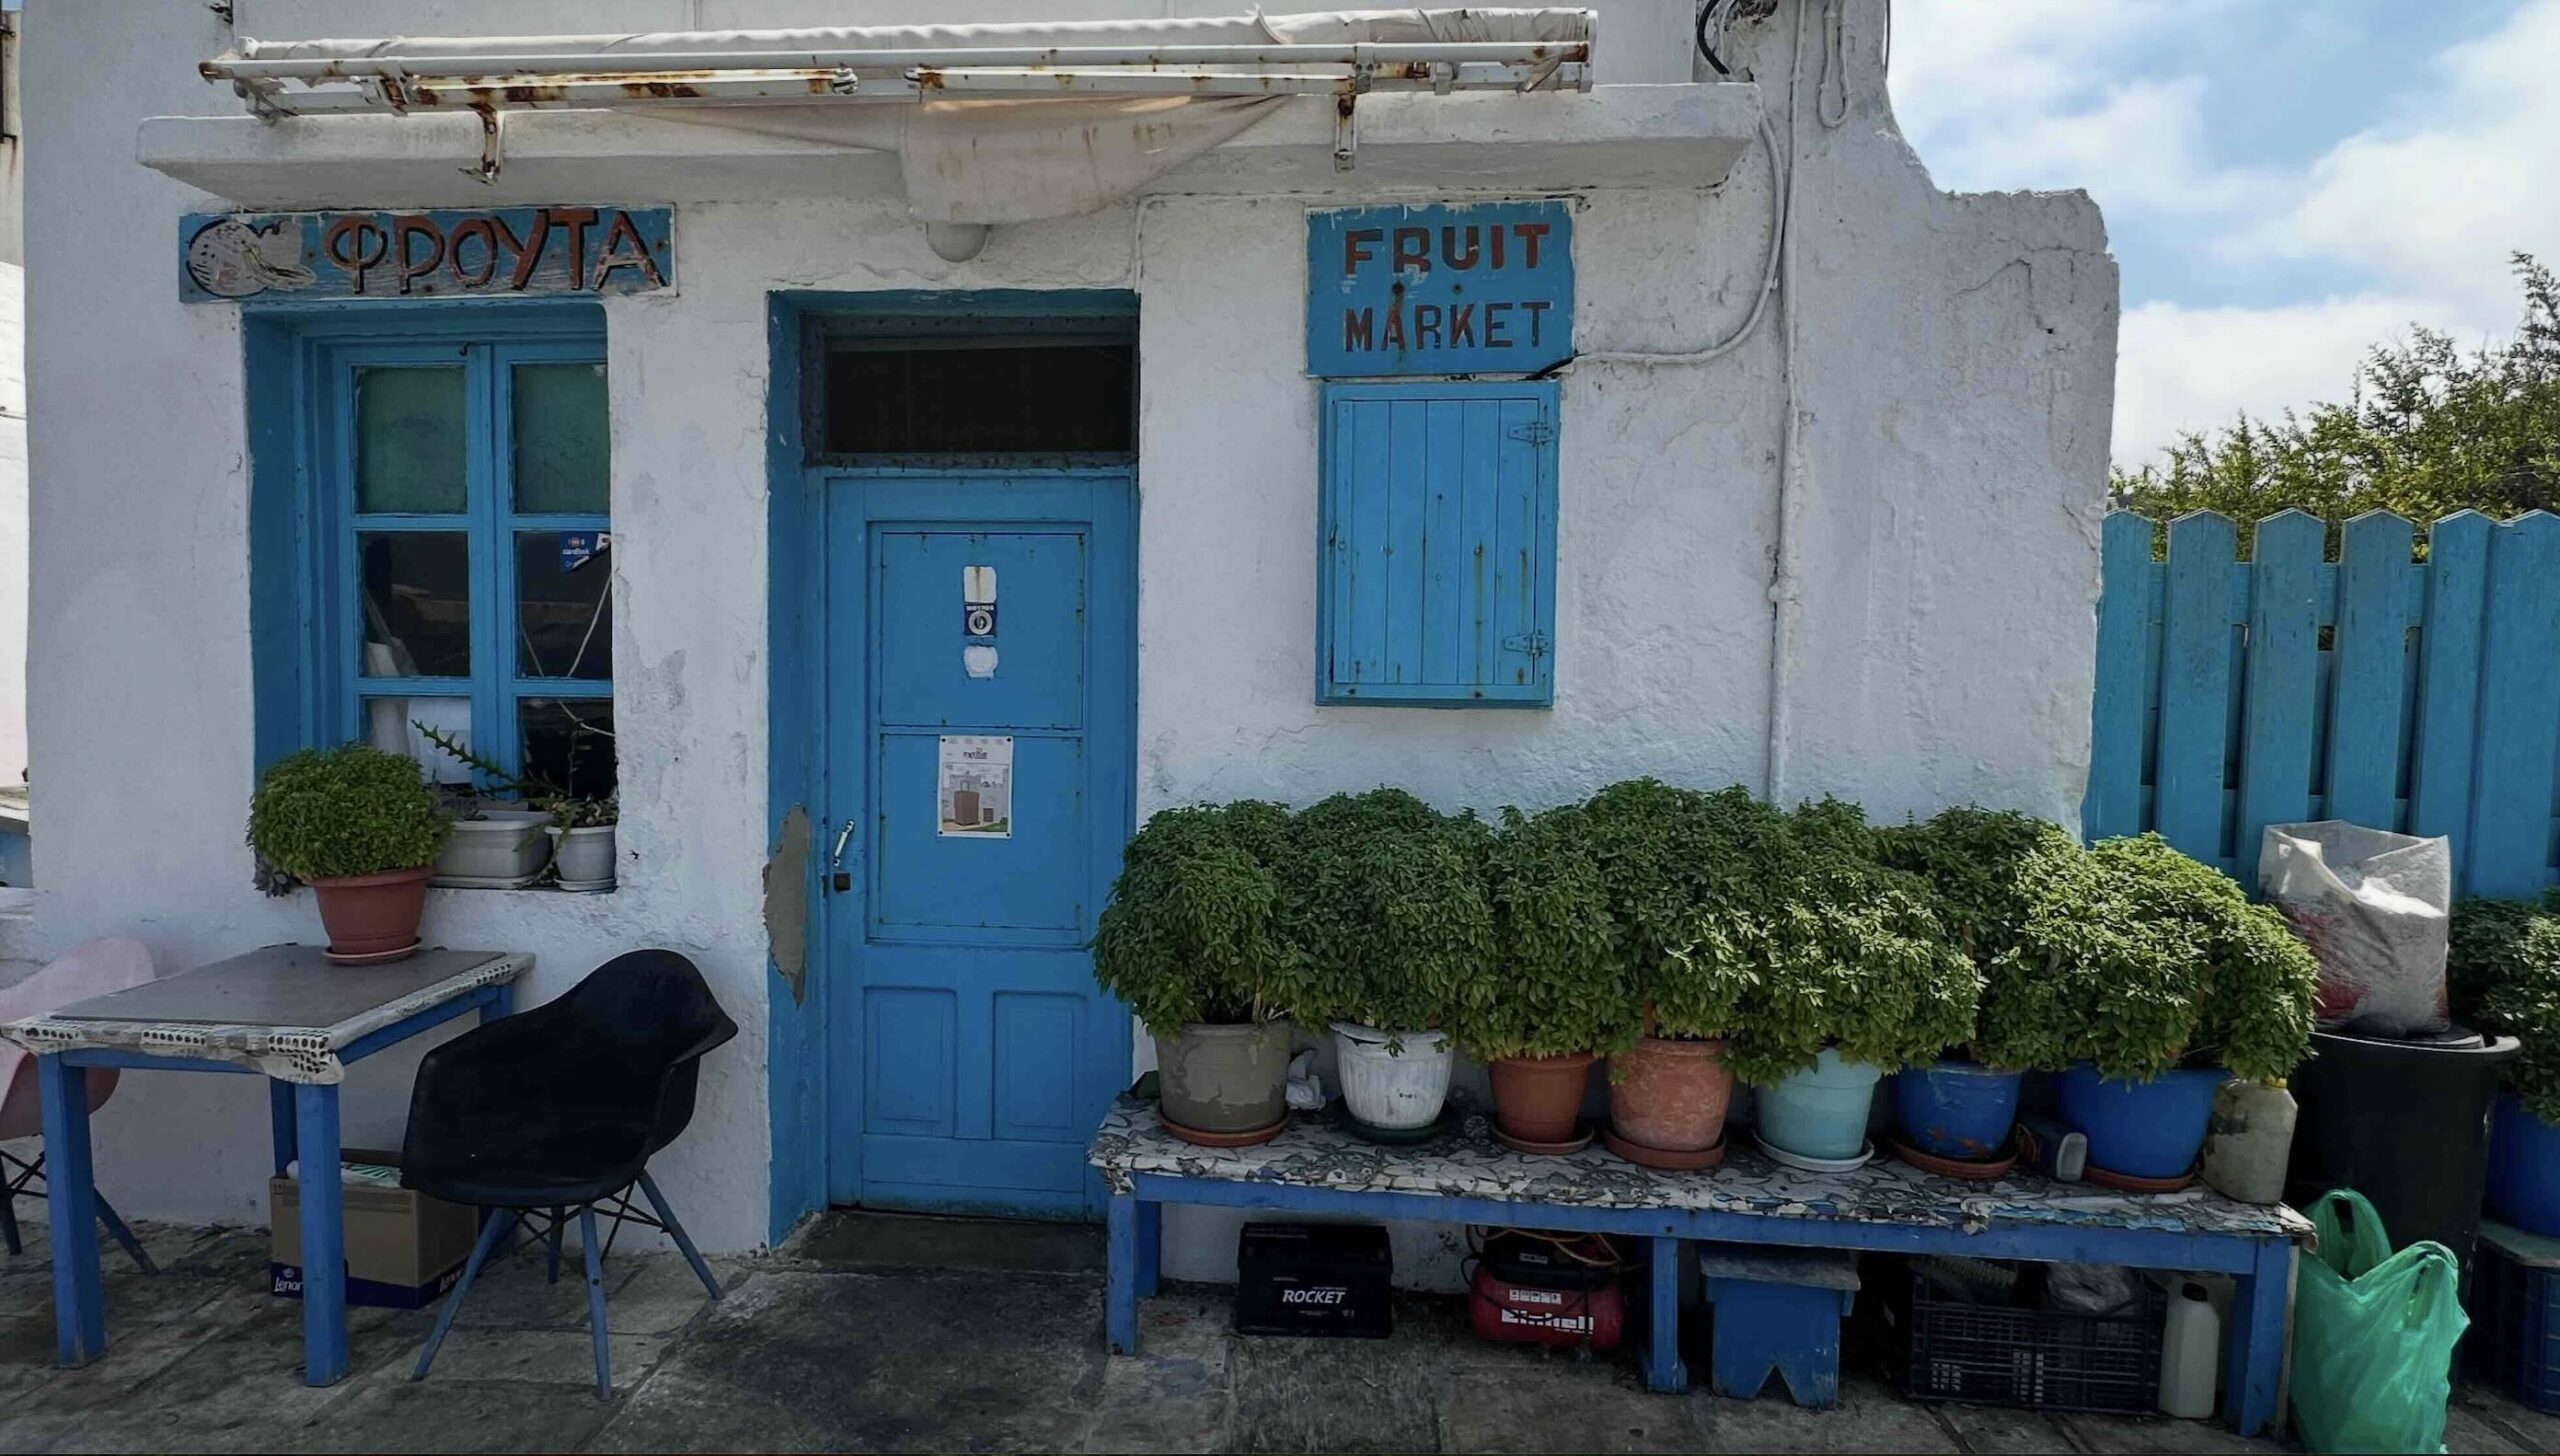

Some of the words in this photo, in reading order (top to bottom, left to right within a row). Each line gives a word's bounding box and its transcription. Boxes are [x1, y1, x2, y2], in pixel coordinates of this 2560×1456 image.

[324, 207, 669, 295] ΦΡΟΥΤΑ
[1344, 223, 1551, 275] FRUIT
[1344, 301, 1552, 353] MARKET
[274, 1276, 304, 1292] Lenor
[1281, 1289, 1346, 1304] ROCKET
